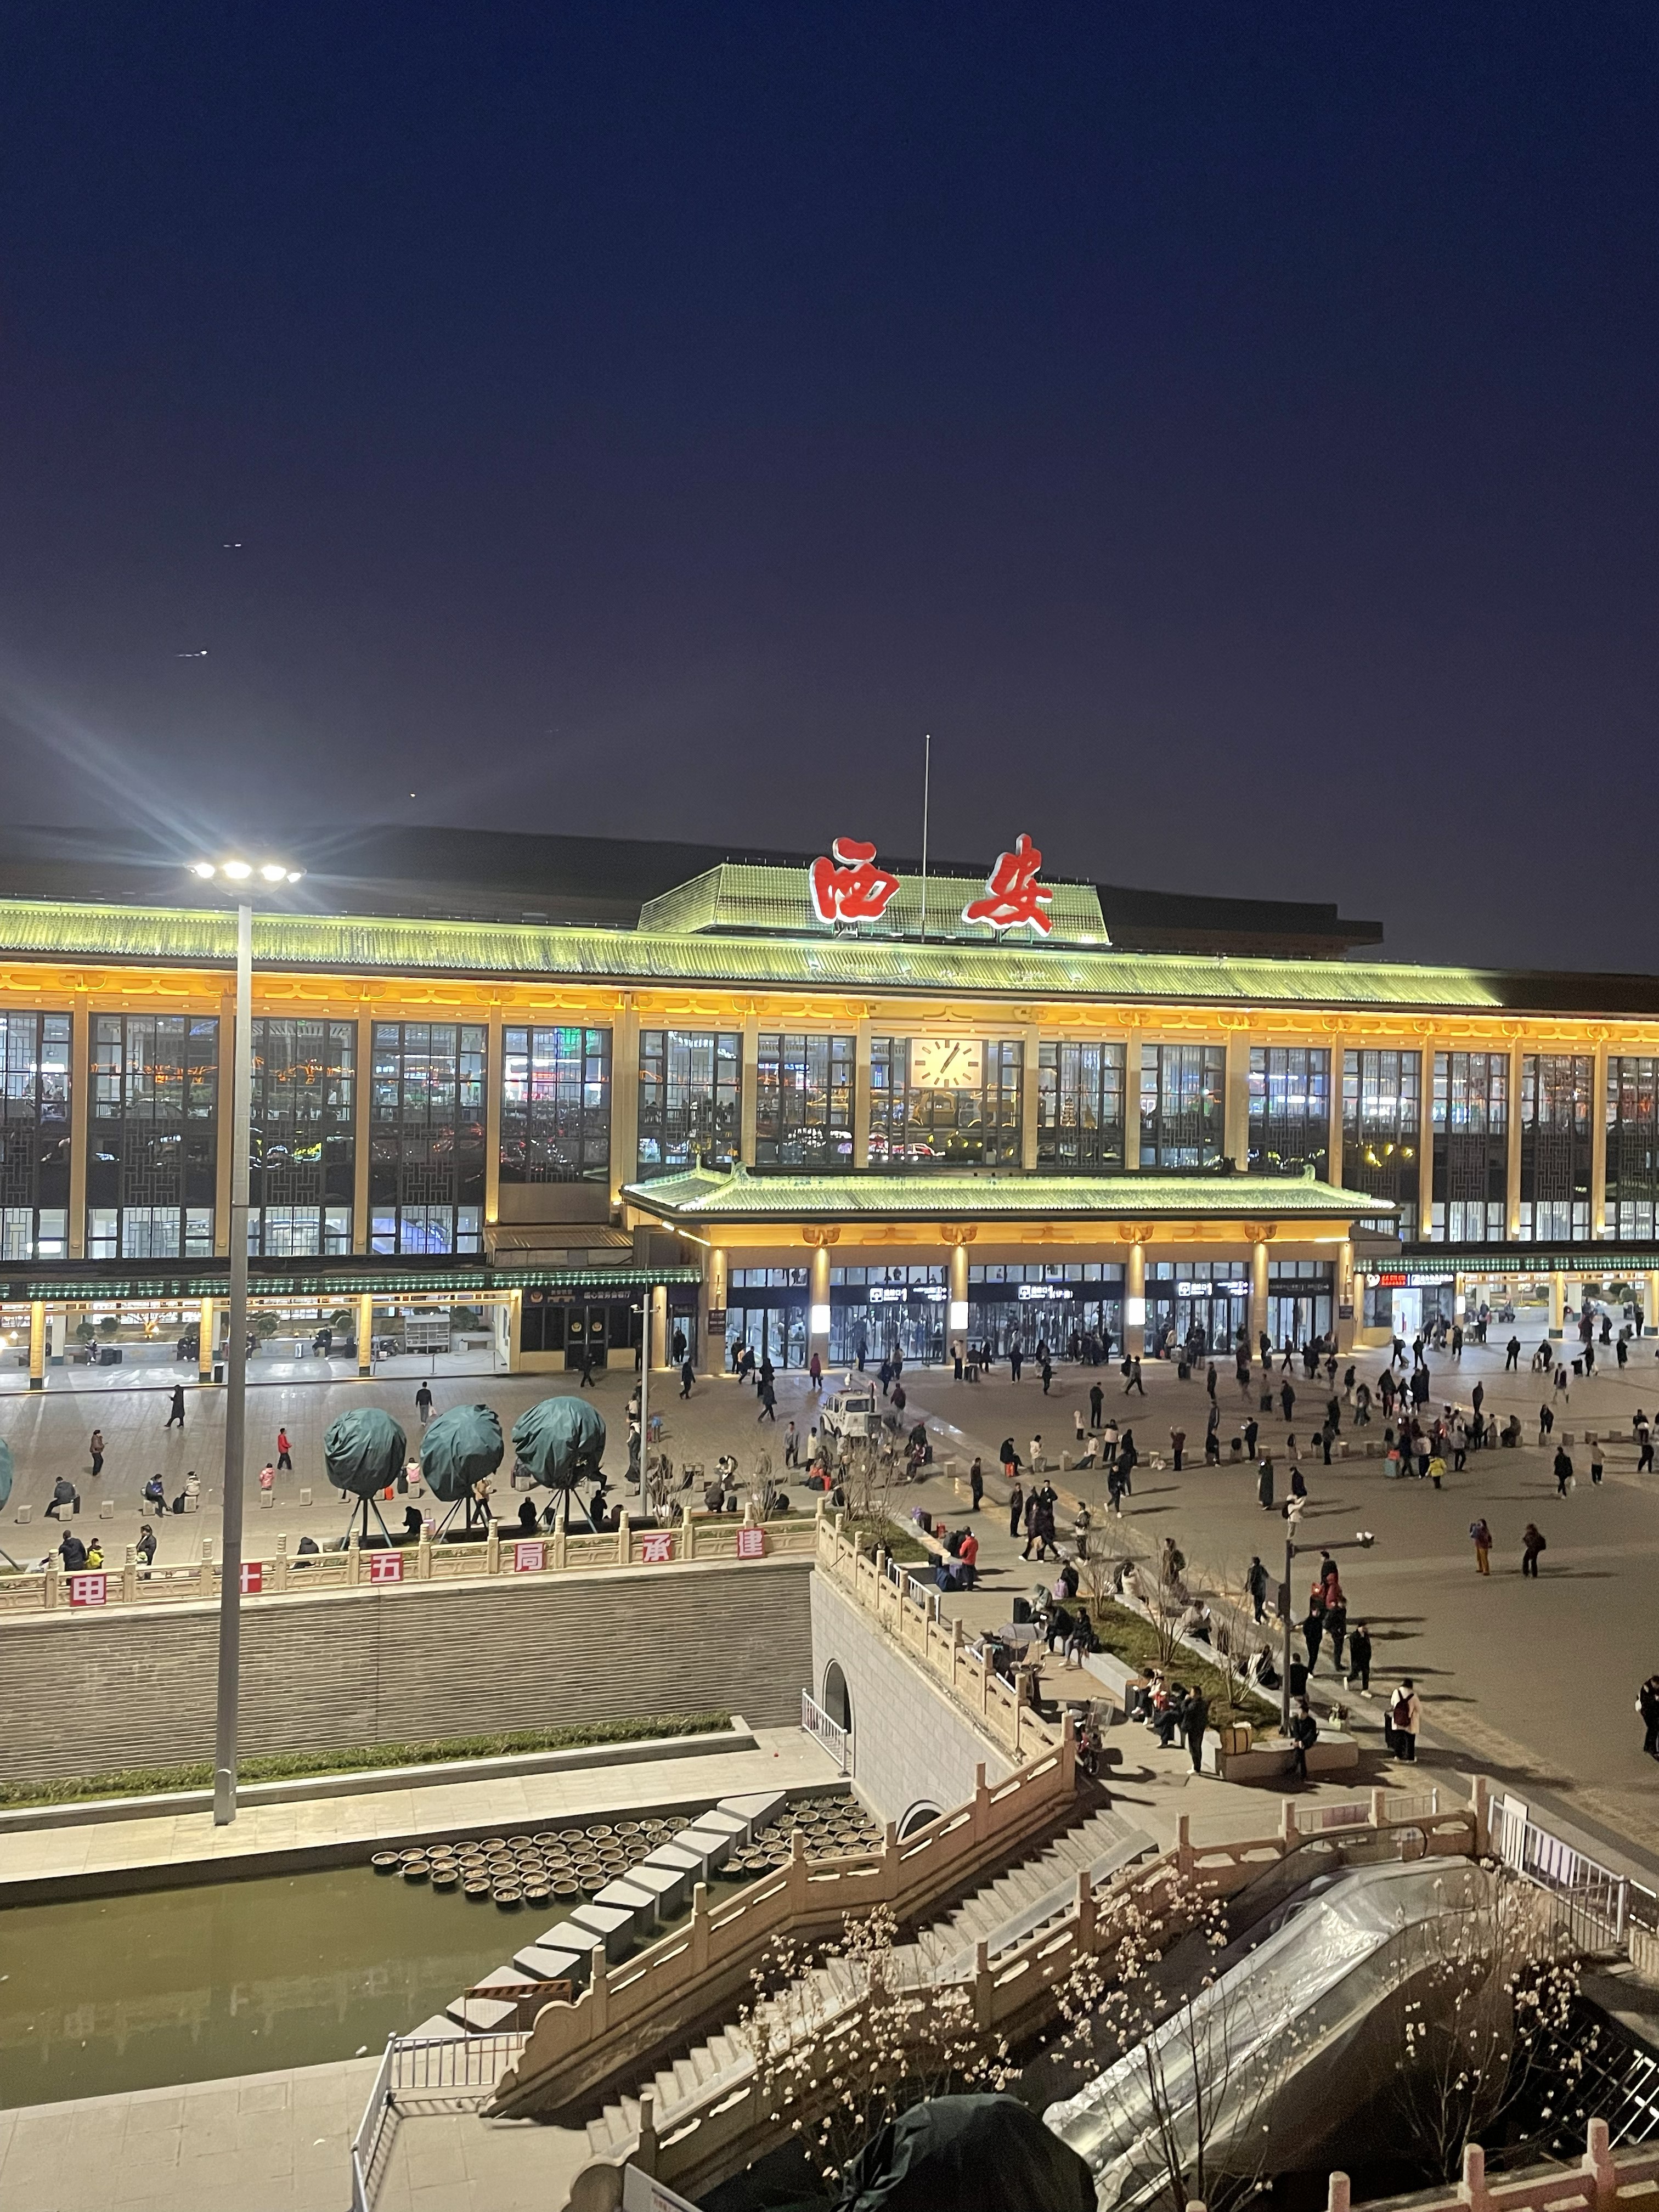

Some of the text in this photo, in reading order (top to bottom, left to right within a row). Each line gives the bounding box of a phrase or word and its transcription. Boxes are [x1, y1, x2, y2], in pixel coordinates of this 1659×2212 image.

[810, 833, 1053, 937] 西安
[73, 1577, 105, 1604] 电
[374, 1554, 400, 1582] 五
[517, 1543, 543, 1570] 局
[644, 1534, 670, 1562] 承
[738, 1530, 764, 1557] 建
